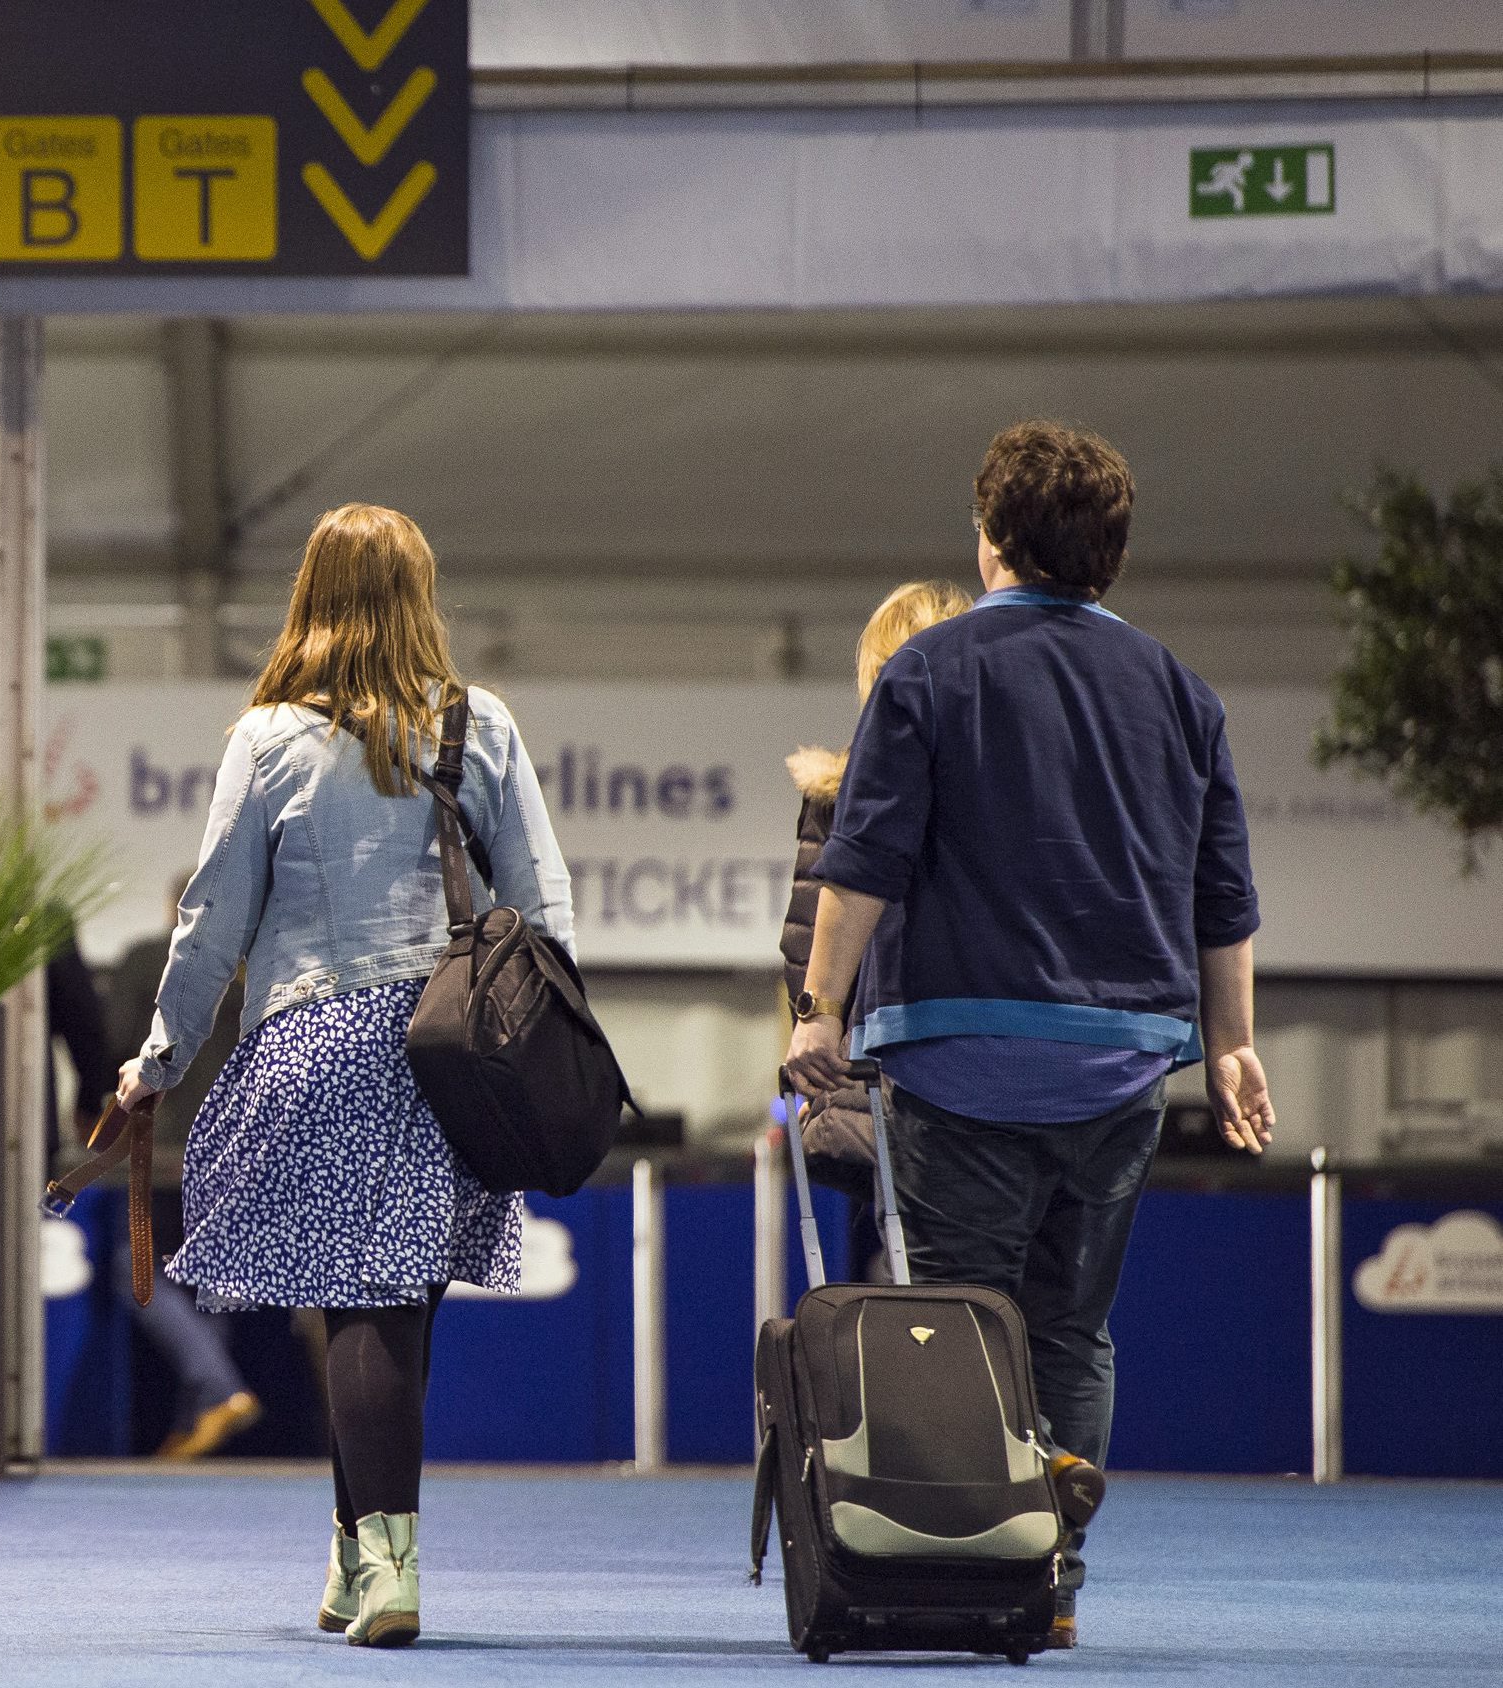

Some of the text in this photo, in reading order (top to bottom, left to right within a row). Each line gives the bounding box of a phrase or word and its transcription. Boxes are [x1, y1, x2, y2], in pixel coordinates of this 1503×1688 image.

[3, 127, 98, 159] Gates
[159, 127, 252, 159] Gates
[21, 168, 81, 247] B
[173, 168, 237, 247] T
